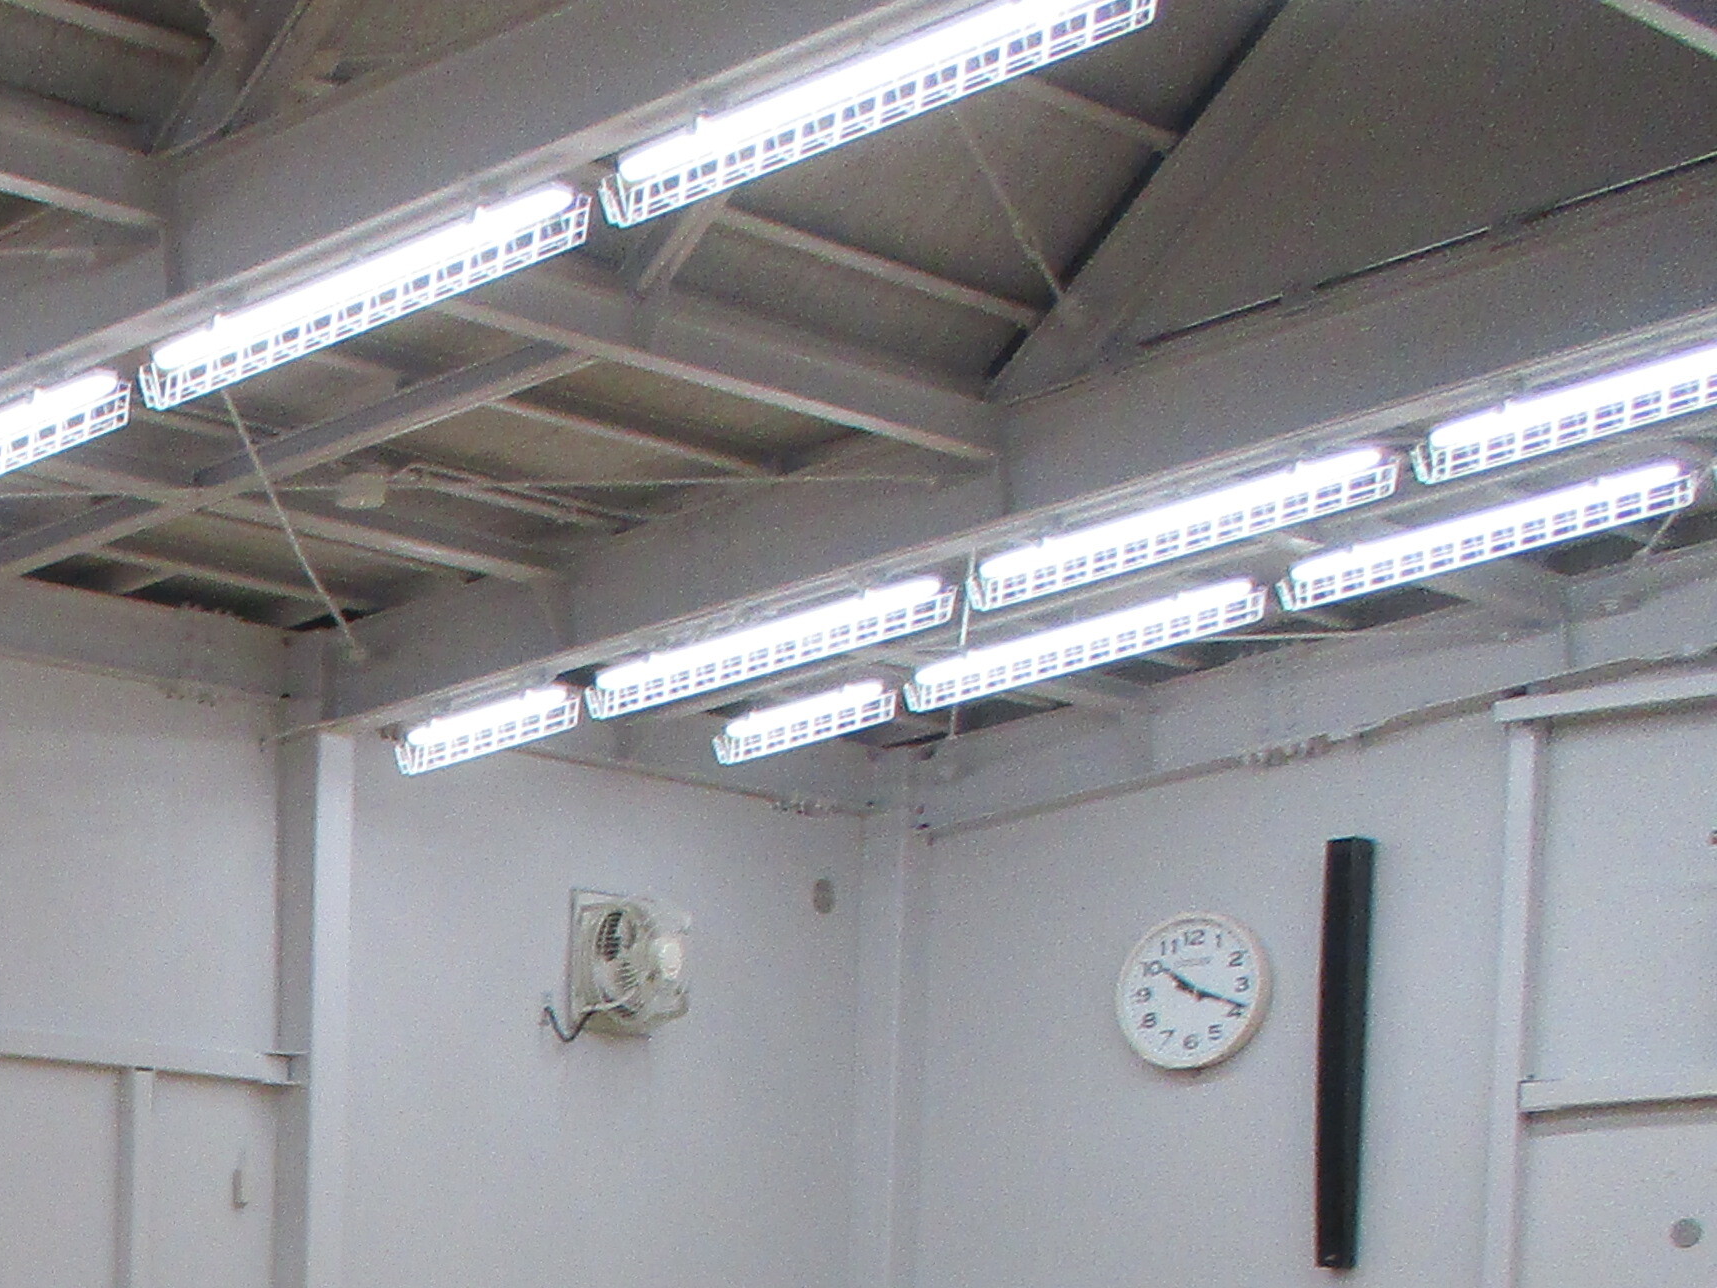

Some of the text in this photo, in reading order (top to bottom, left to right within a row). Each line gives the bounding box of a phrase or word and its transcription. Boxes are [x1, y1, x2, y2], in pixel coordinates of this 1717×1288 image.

[1184, 929, 1206, 946] 12
[1160, 940, 1178, 956] 11
[1227, 950, 1248, 967] 2
[1141, 959, 1165, 977] 10
[1234, 976, 1250, 993] 3
[1134, 986, 1152, 1003] 9
[1140, 1012, 1158, 1029] 8
[1160, 1029, 1176, 1047] 7
[1207, 1024, 1223, 1040] 5
[1182, 1034, 1200, 1050] 6
